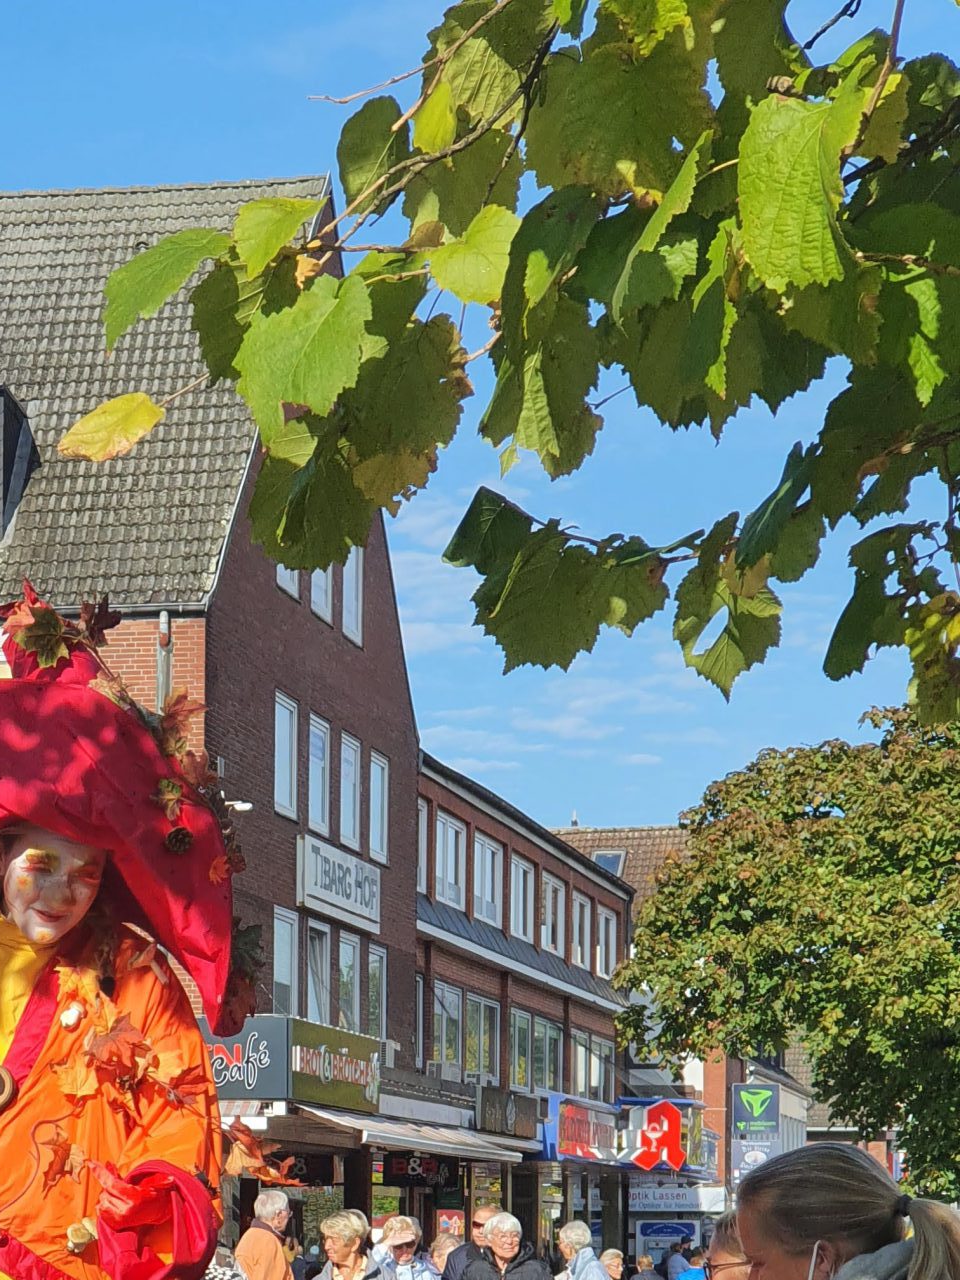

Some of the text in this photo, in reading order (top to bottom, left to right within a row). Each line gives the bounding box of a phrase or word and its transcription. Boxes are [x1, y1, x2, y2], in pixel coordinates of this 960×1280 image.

[311, 843, 378, 911] TIBARG HOF
[211, 1031, 270, 1090] Café
[653, 1190, 687, 1201] Lassen
